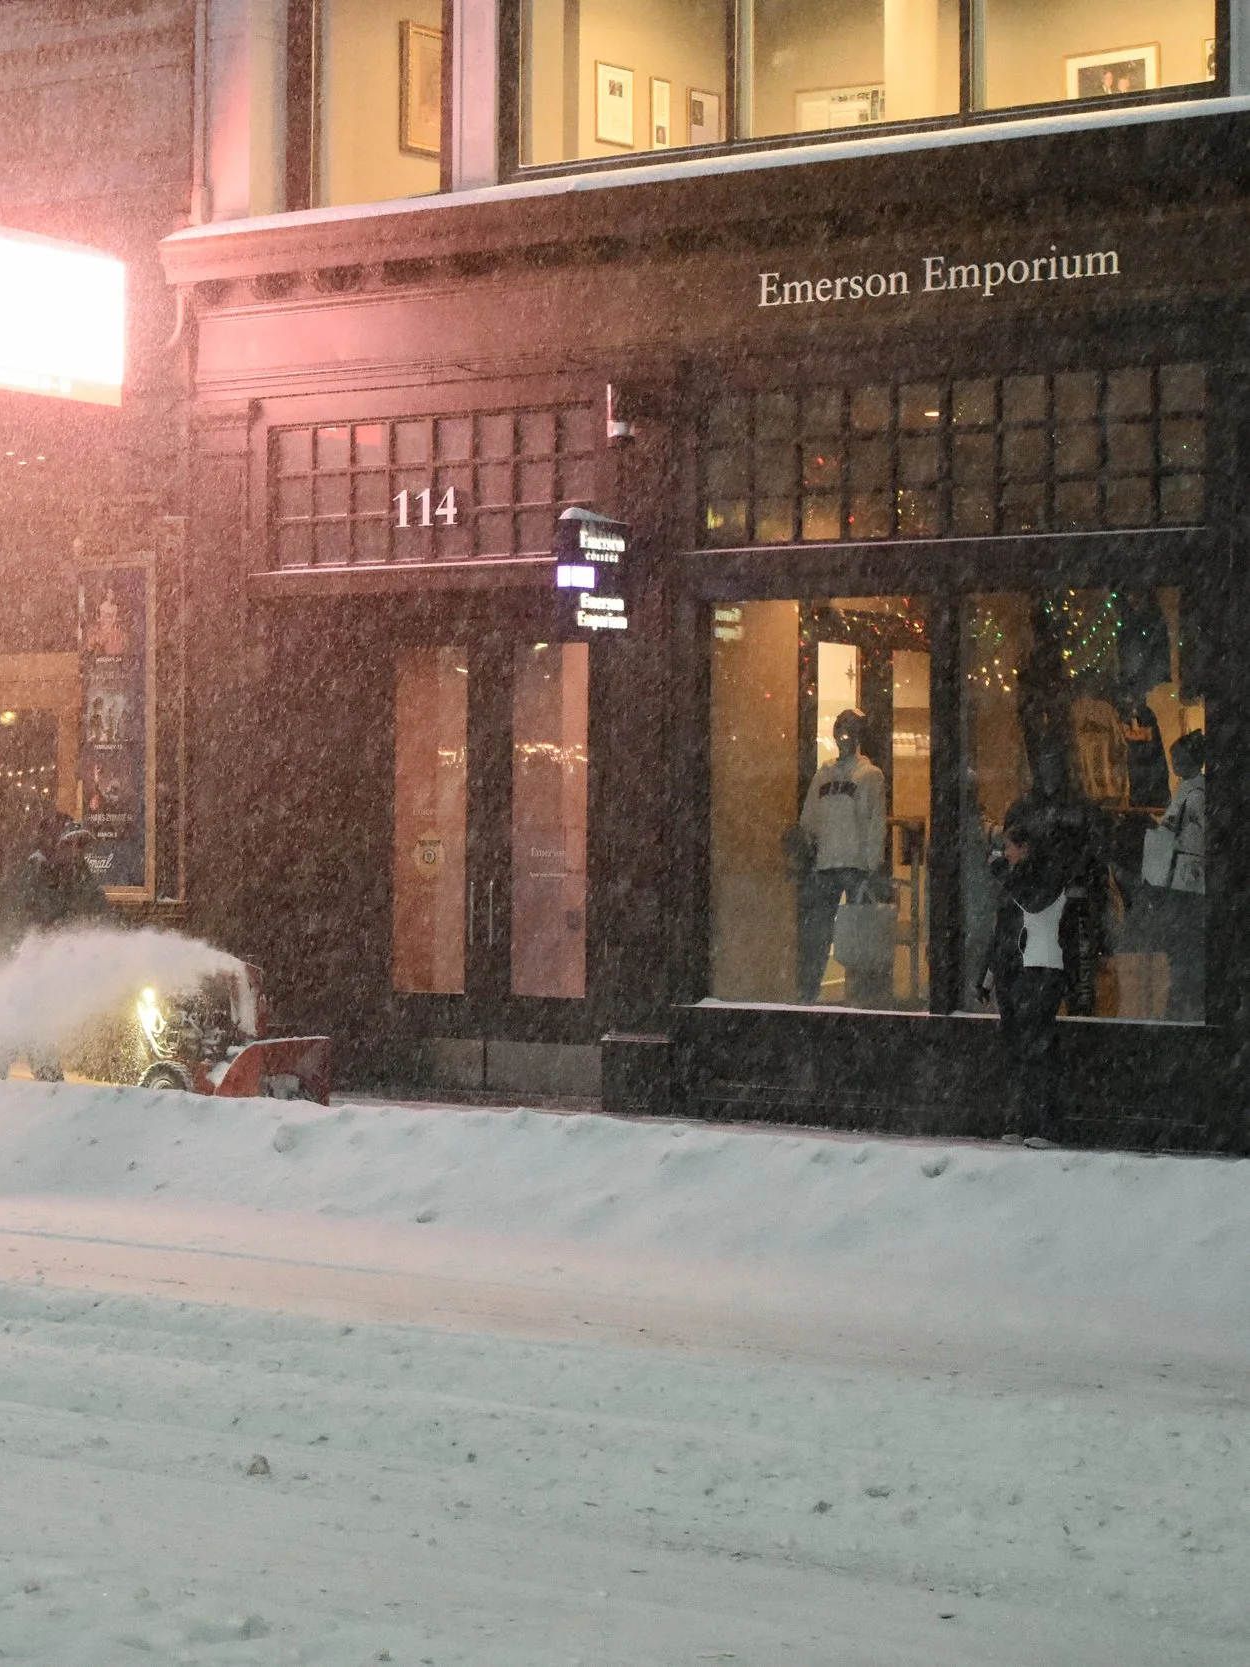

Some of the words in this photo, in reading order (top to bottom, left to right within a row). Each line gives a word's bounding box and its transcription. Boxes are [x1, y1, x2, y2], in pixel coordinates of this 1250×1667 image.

[757, 270, 910, 307] Emerson
[921, 244, 1121, 297] Emporium
[392, 486, 458, 528] 114
